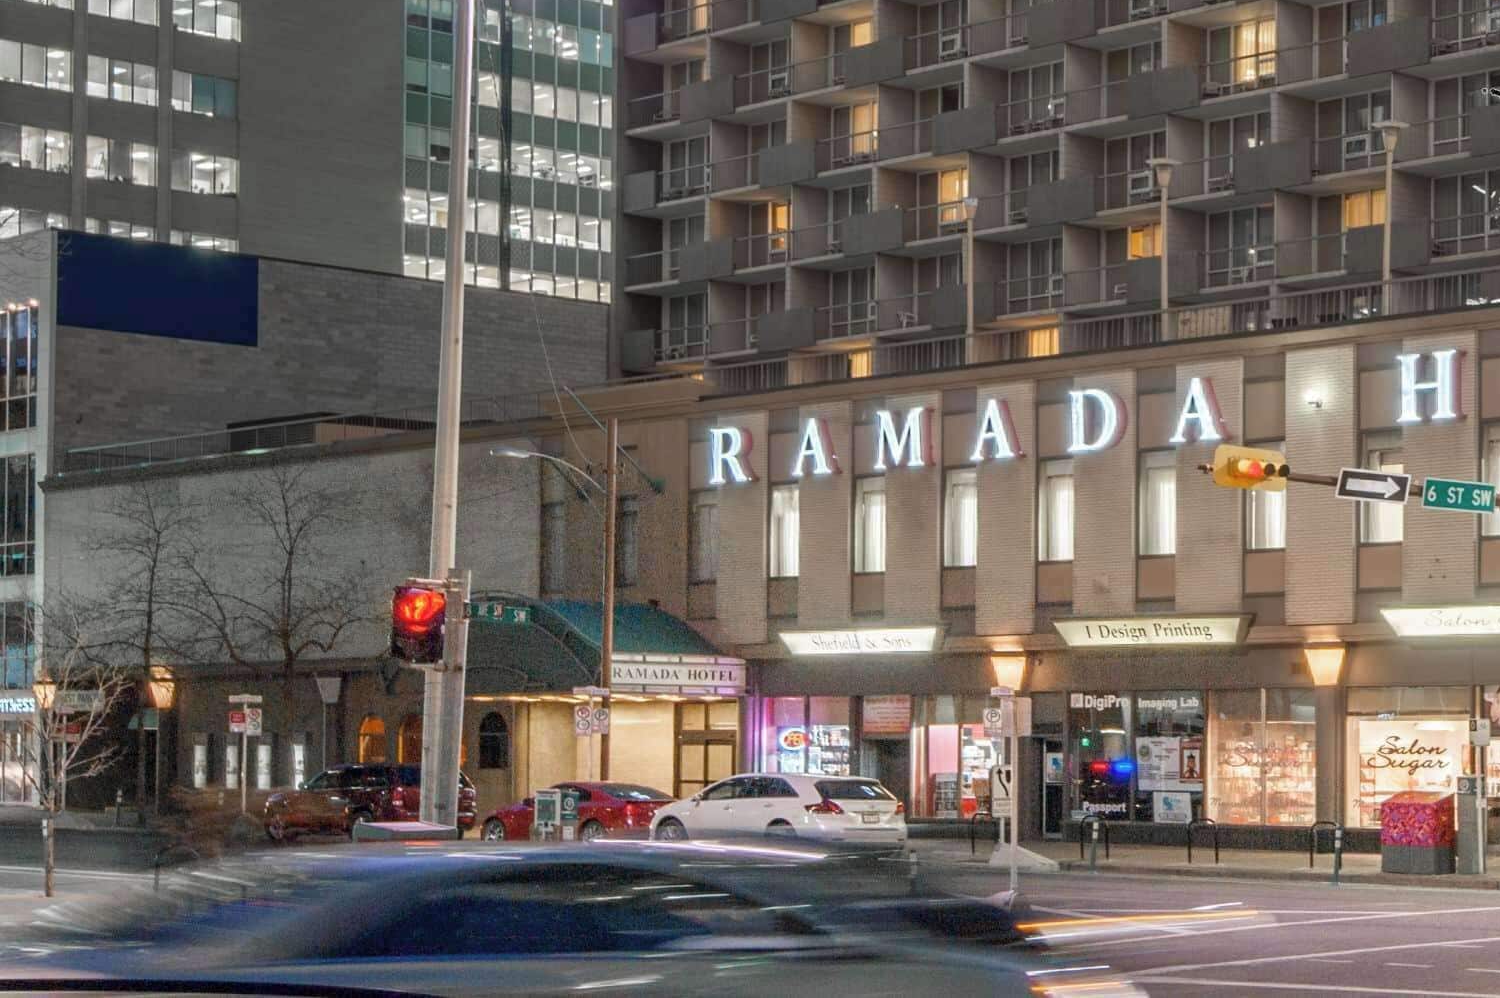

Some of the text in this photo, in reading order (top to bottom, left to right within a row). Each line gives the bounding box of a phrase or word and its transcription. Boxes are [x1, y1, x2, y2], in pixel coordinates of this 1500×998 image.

[709, 377, 1228, 484] RAMADA
[1427, 486, 1492, 506] 6 ST SW
[1423, 609, 1491, 627] Salon
[1098, 623, 1147, 642] Design
[1152, 622, 1213, 641] Printing
[612, 667, 738, 682] RAMADA HOTEL
[1084, 694, 1199, 711] DigiPro Imaging Lab
[1378, 736, 1449, 755] Salon
[1367, 751, 1450, 775] Sugar
[1083, 801, 1127, 815] Passport
